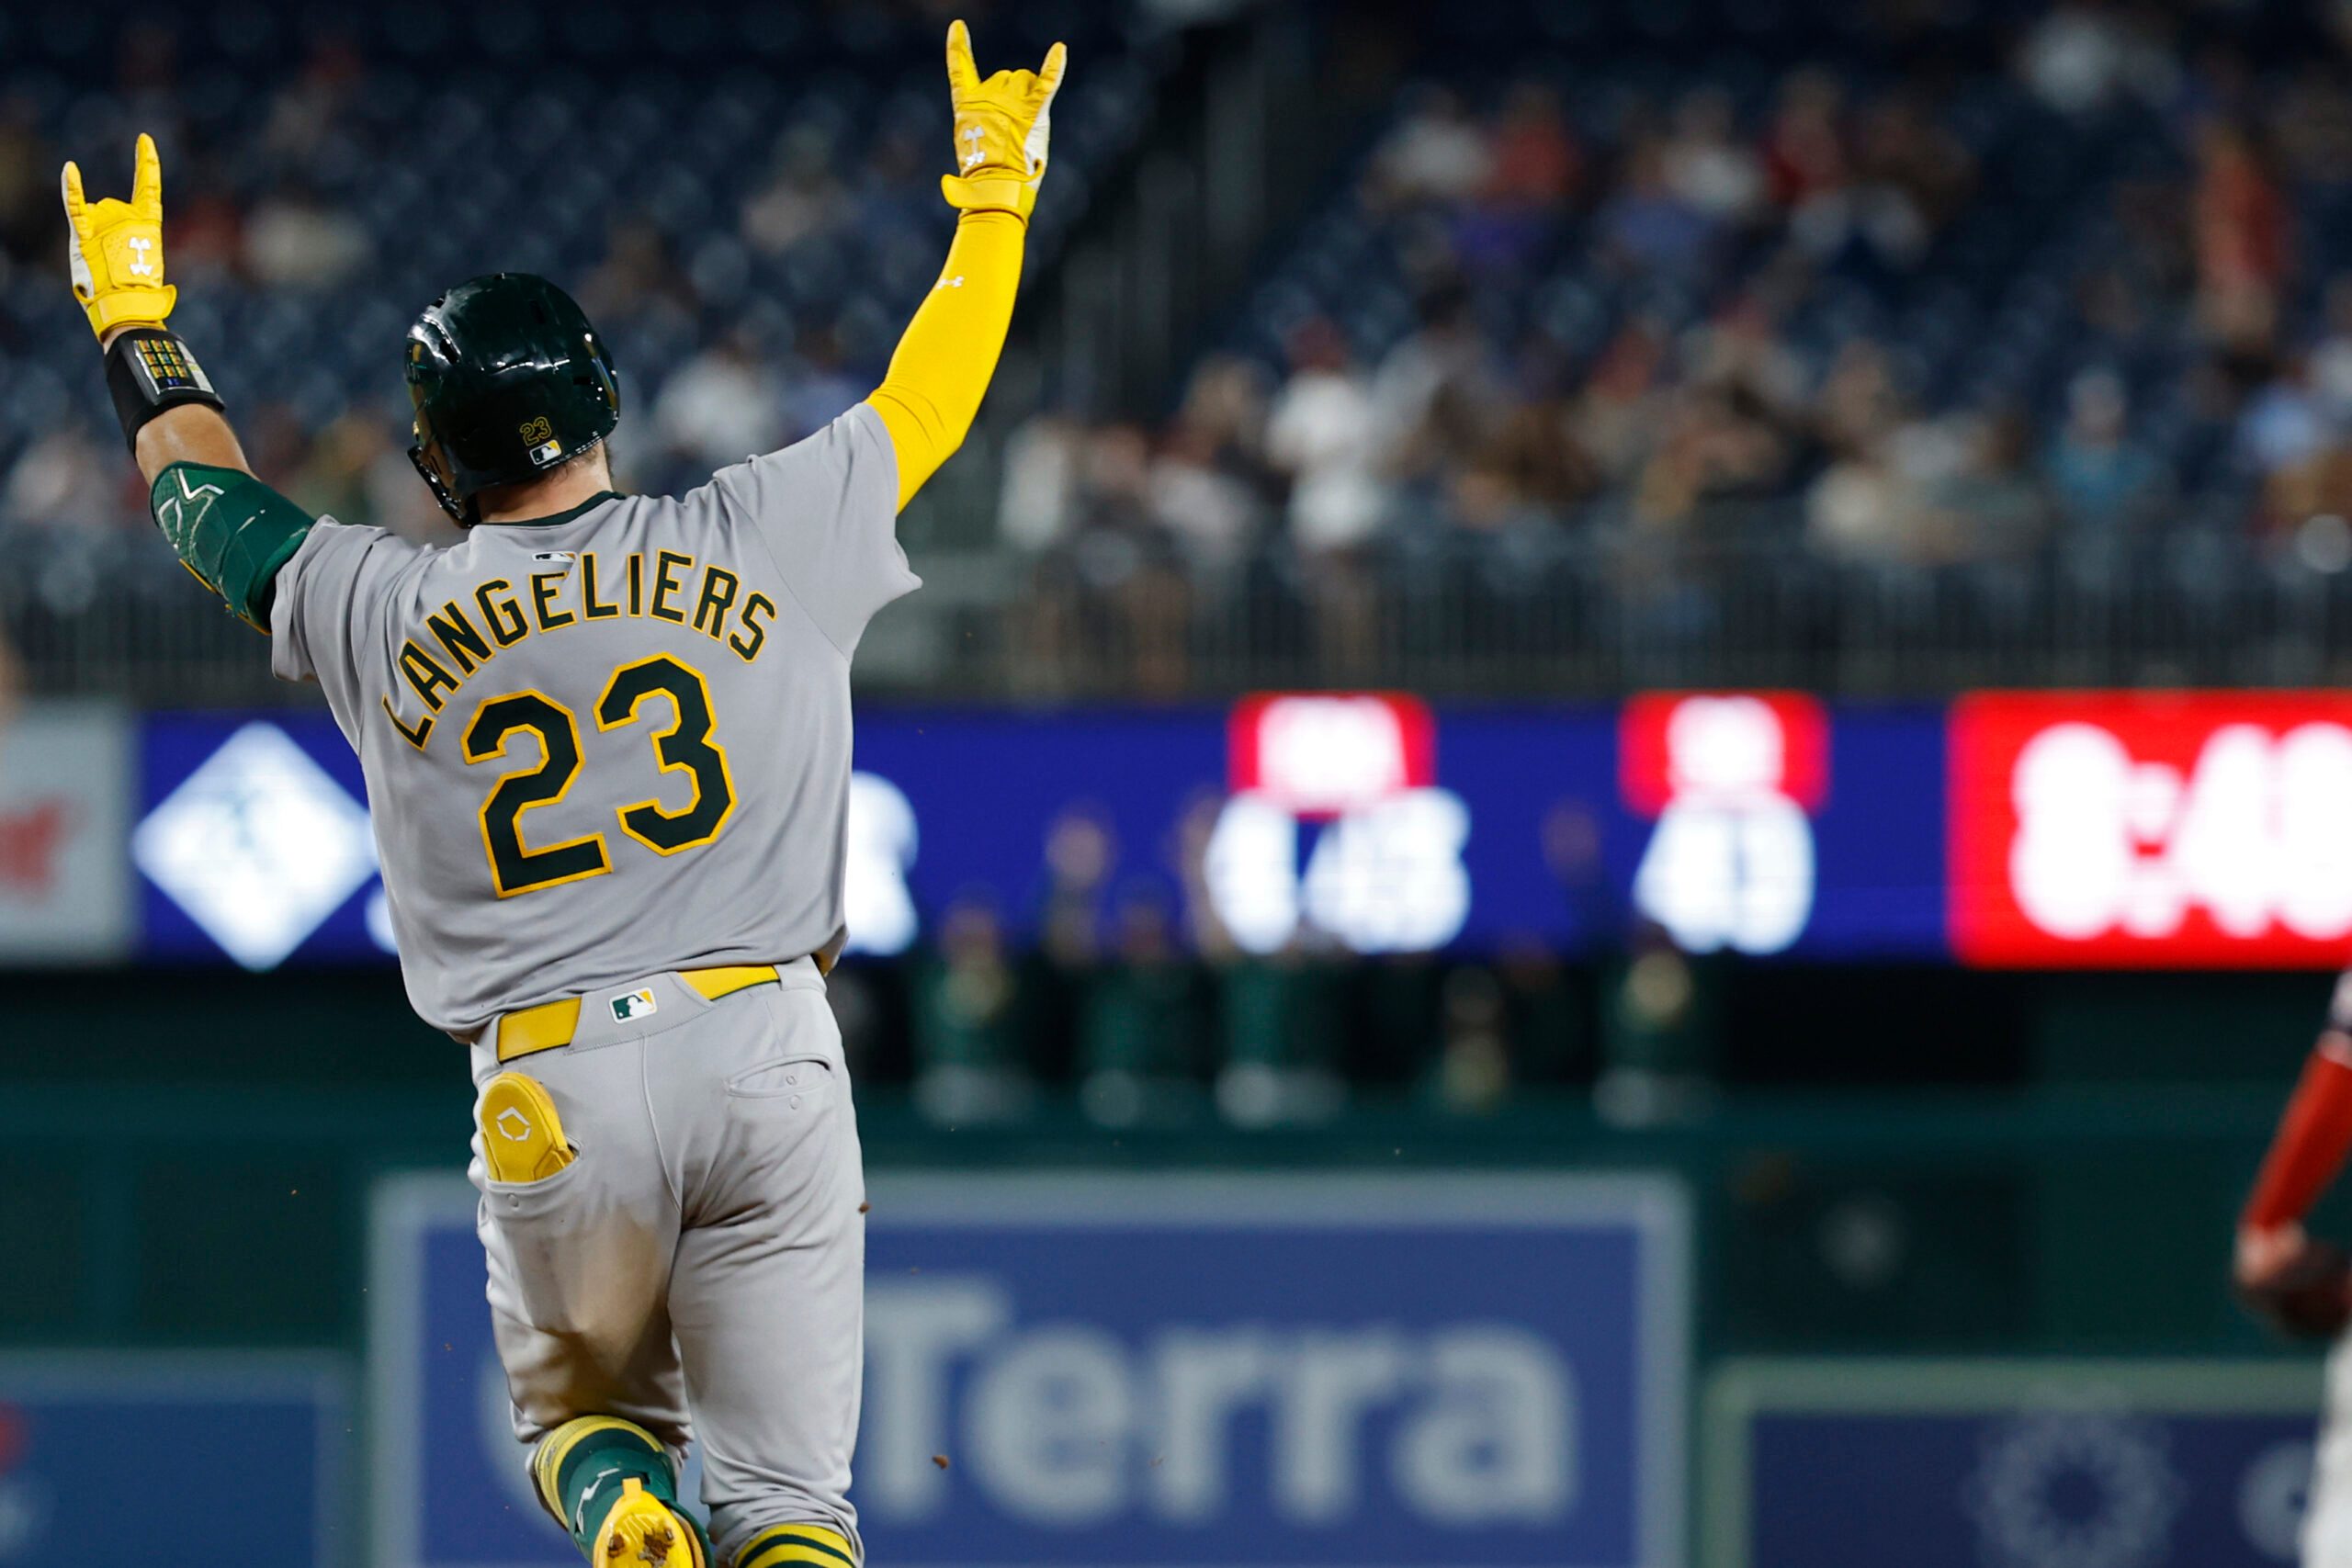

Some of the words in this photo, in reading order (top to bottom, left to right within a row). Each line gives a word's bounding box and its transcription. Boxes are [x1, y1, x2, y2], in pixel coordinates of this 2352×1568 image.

[519, 416, 552, 446] 23
[382, 548, 777, 751] LANGELIERS
[461, 652, 738, 898] 23
